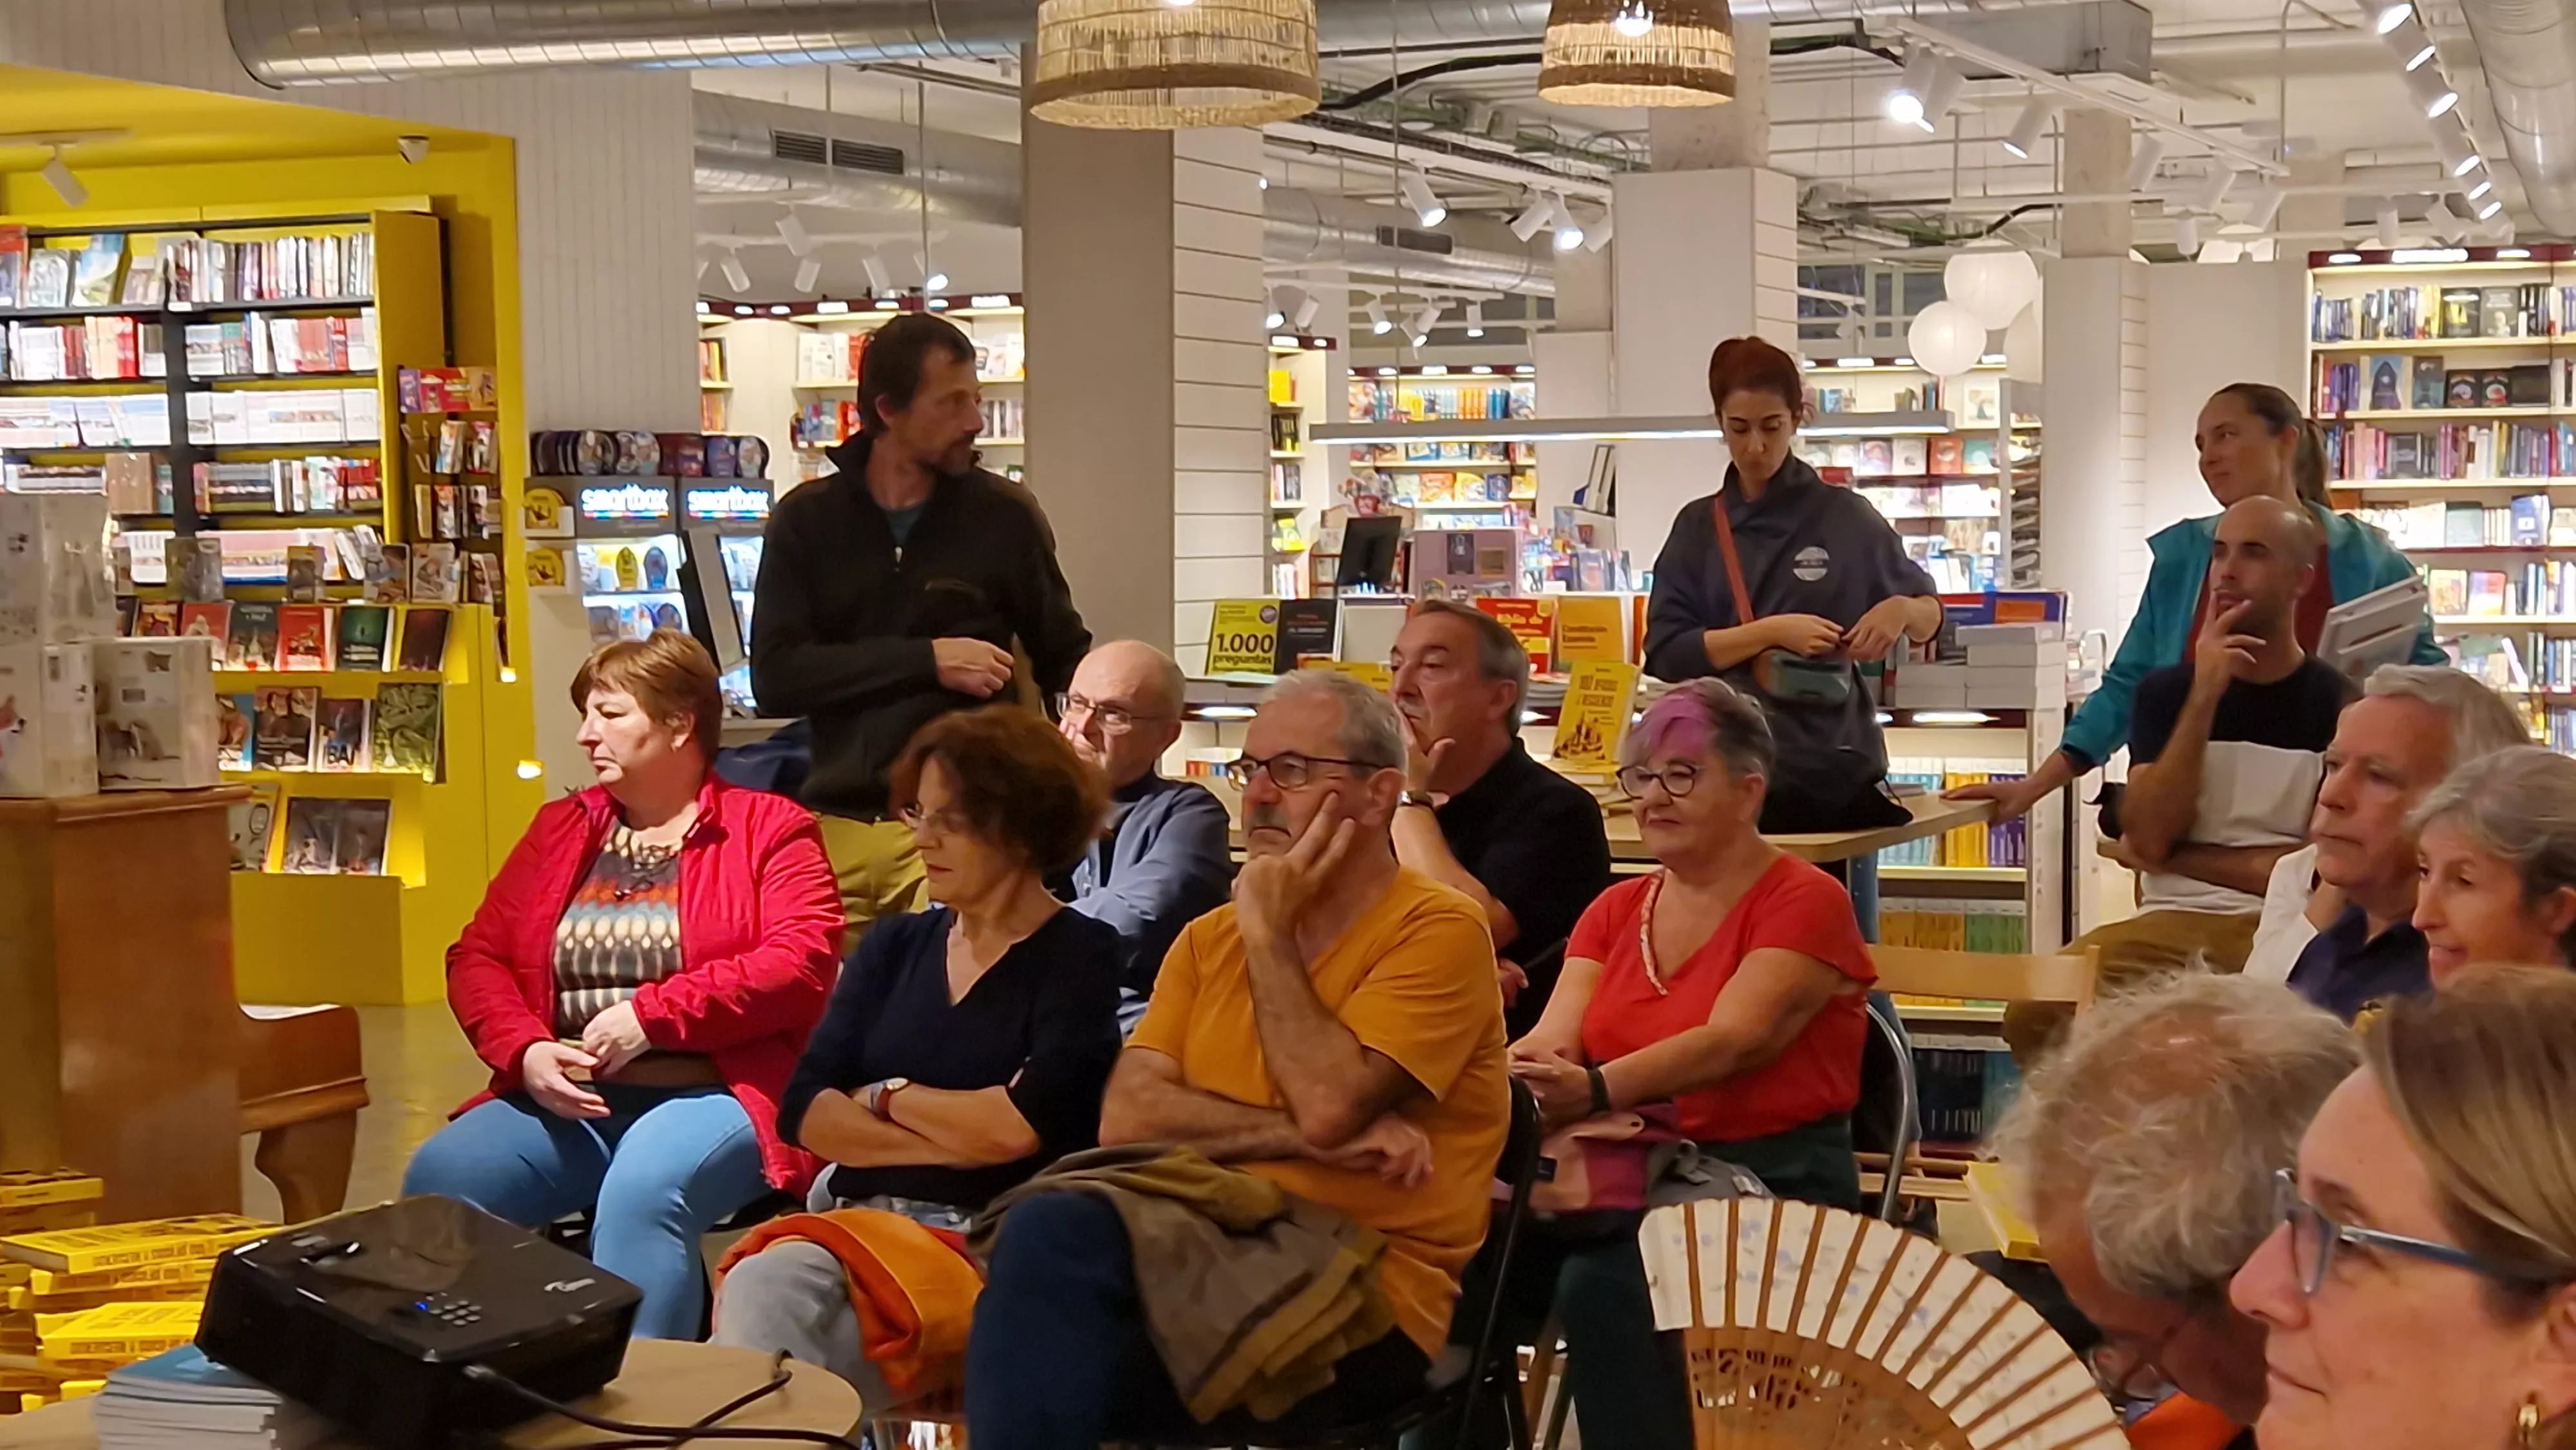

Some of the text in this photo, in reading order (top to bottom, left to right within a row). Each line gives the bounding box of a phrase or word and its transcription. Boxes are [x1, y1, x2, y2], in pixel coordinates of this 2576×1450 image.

[581, 483, 669, 512] smartbox
[687, 485, 770, 512] smartbox
[1215, 633, 1274, 654] 1.000
[1212, 654, 1273, 666] preguntas
